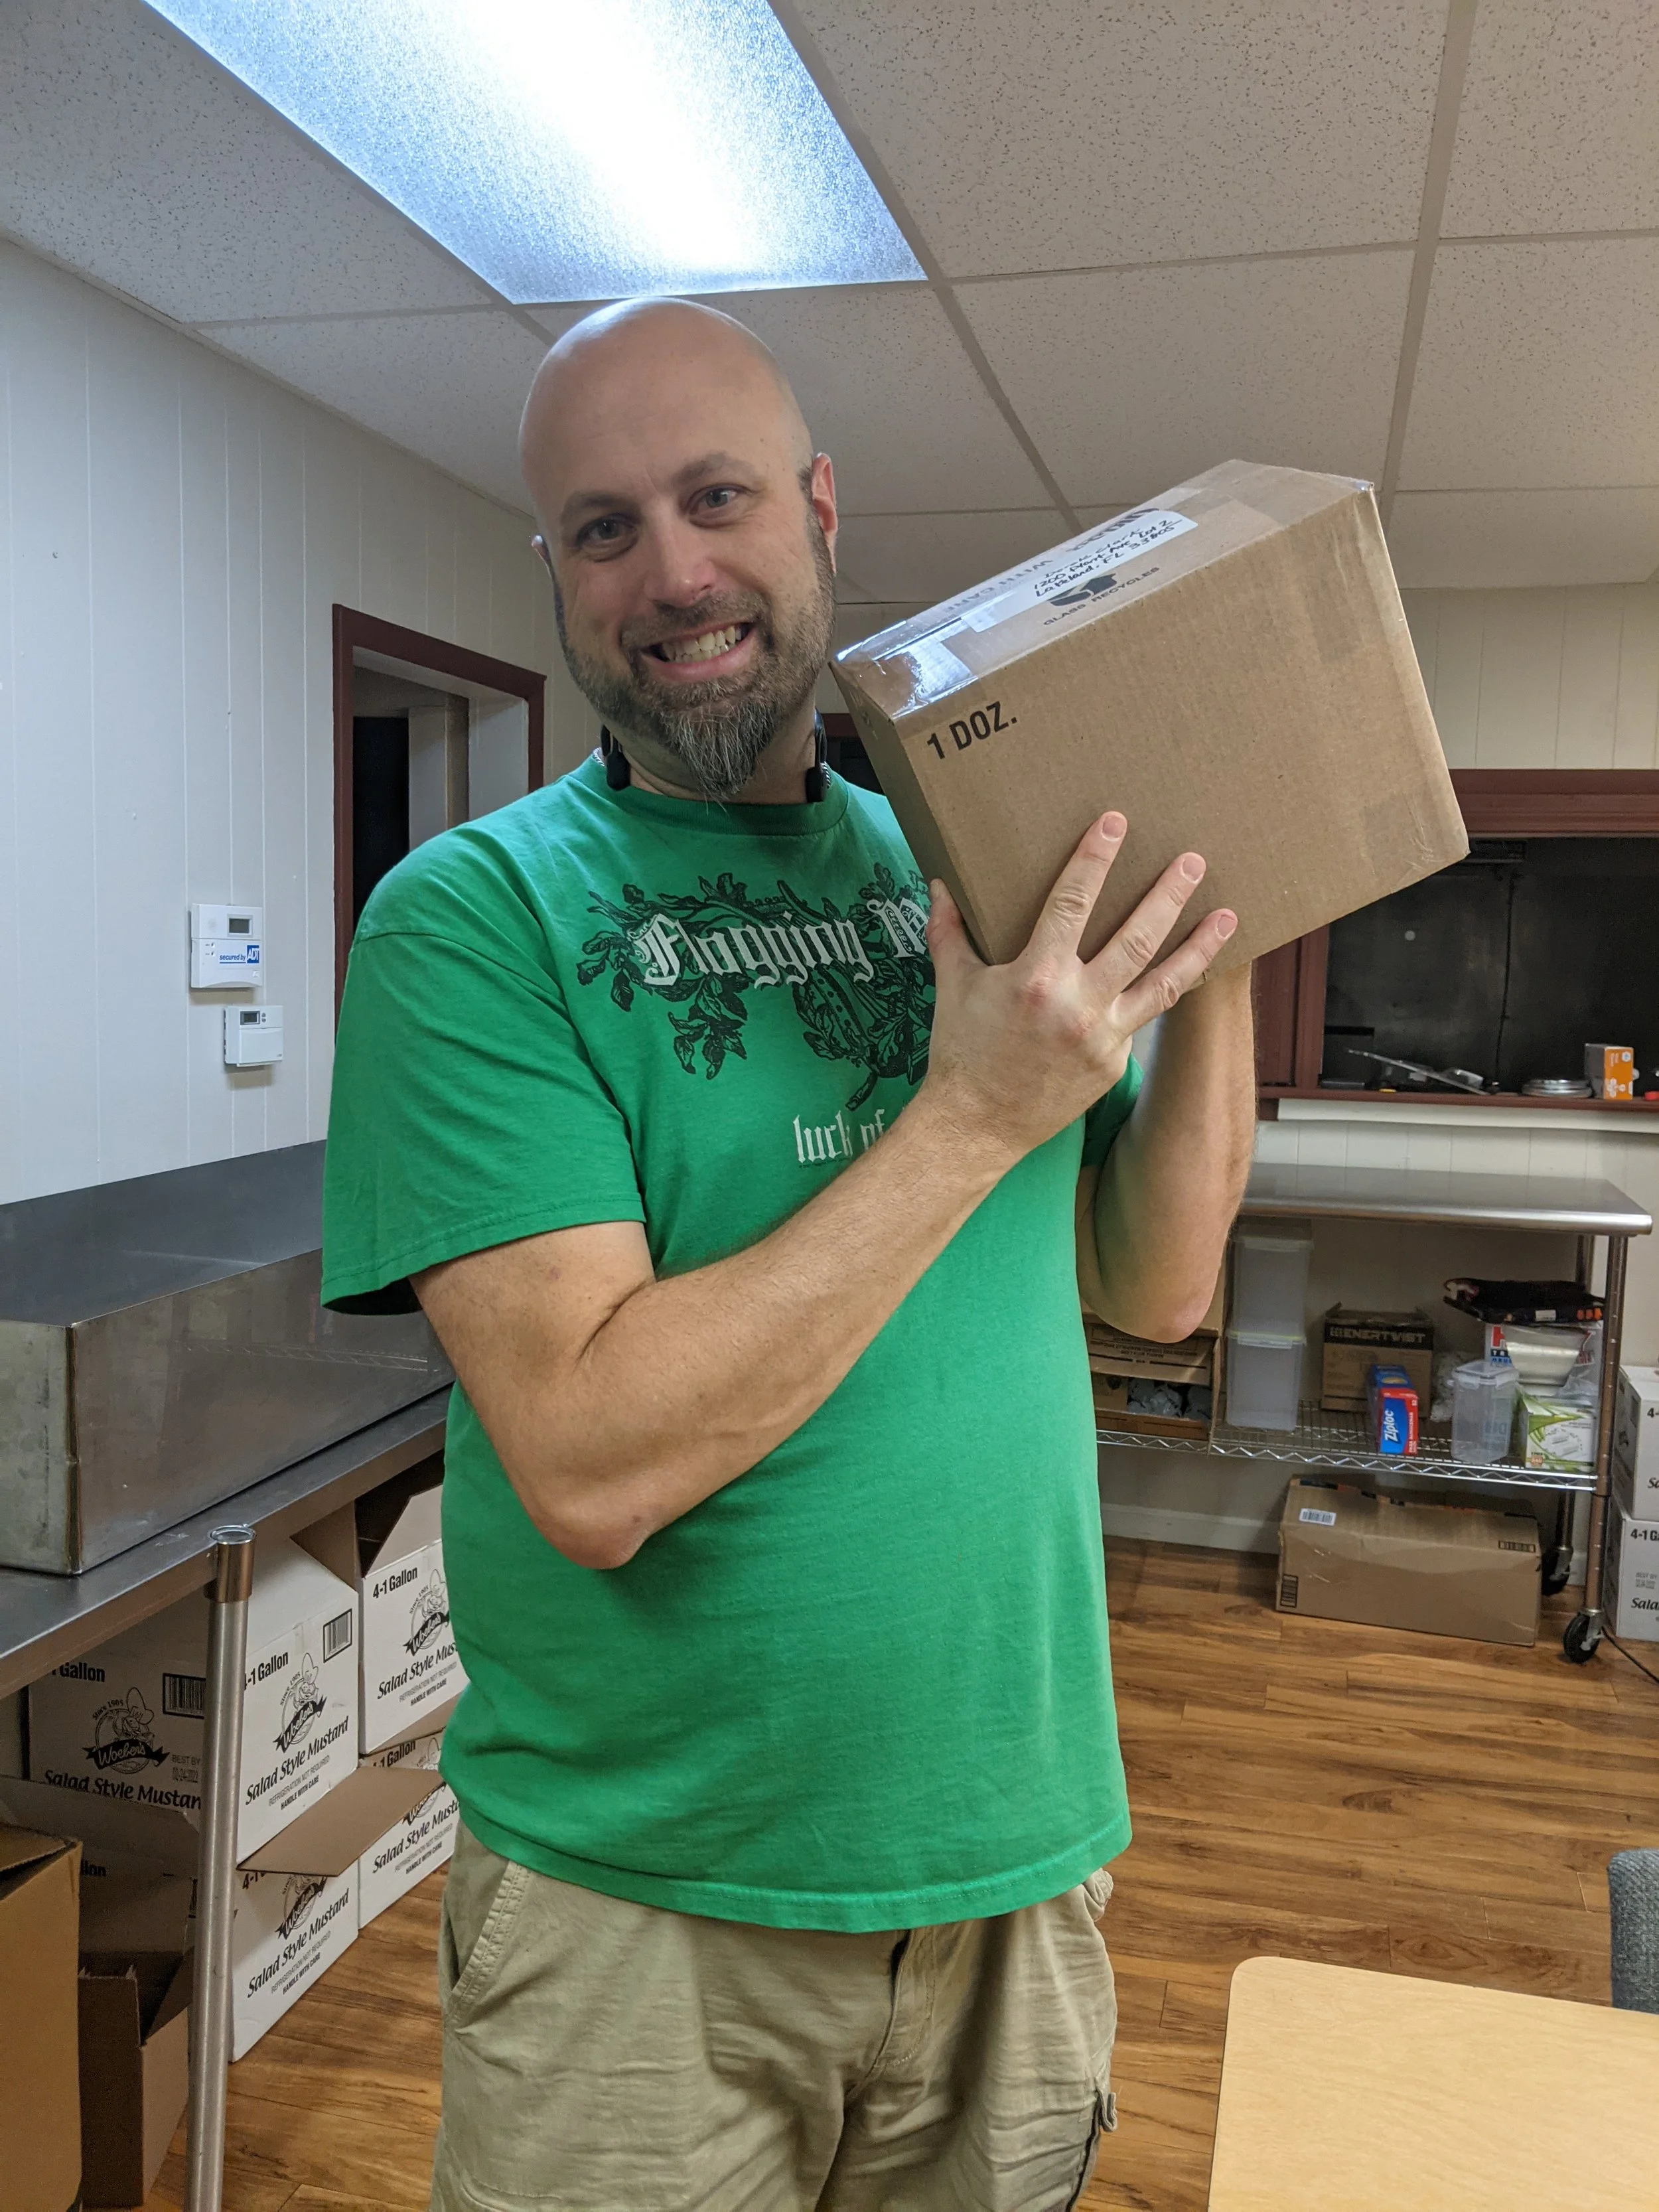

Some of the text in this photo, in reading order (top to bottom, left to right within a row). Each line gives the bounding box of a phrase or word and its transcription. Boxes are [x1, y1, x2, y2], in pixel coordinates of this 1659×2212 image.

[1035, 573, 1066, 590] 1200
[1137, 524, 1159, 539] Lot
[1103, 552, 1125, 564] FL
[1043, 567, 1160, 626] GLASS RECYCLES
[926, 700, 1017, 760] 1 DOZ.
[792, 1109, 853, 1163] luck
[1383, 1410, 1400, 1442] Ziploc
[1630, 1528, 1648, 1541] 4-1
[372, 1567, 418, 1599] 4-1 Gallon
[257, 1651, 289, 1682] Gallon
[377, 1641, 457, 1700] Salad Style Mus
[410, 1678, 447, 1706] HANDLE WITH CARE
[246, 1715, 349, 1805] Salad Style Mustard
[387, 1739, 416, 1768] Gallon
[44, 1769, 90, 1793] Salad
[137, 1784, 201, 1810] Mustar
[281, 1774, 320, 1810] HANDLE WITH CARE
[301, 1769, 311, 1783] NOT
[372, 1838, 403, 1874] Salad
[405, 1820, 431, 1850] Style
[405, 1841, 443, 1875] HANDLE WITH CARE
[247, 1887, 350, 1998] Salad Style Mustard
[282, 1952, 321, 1995] HANDLE WITH CARE
